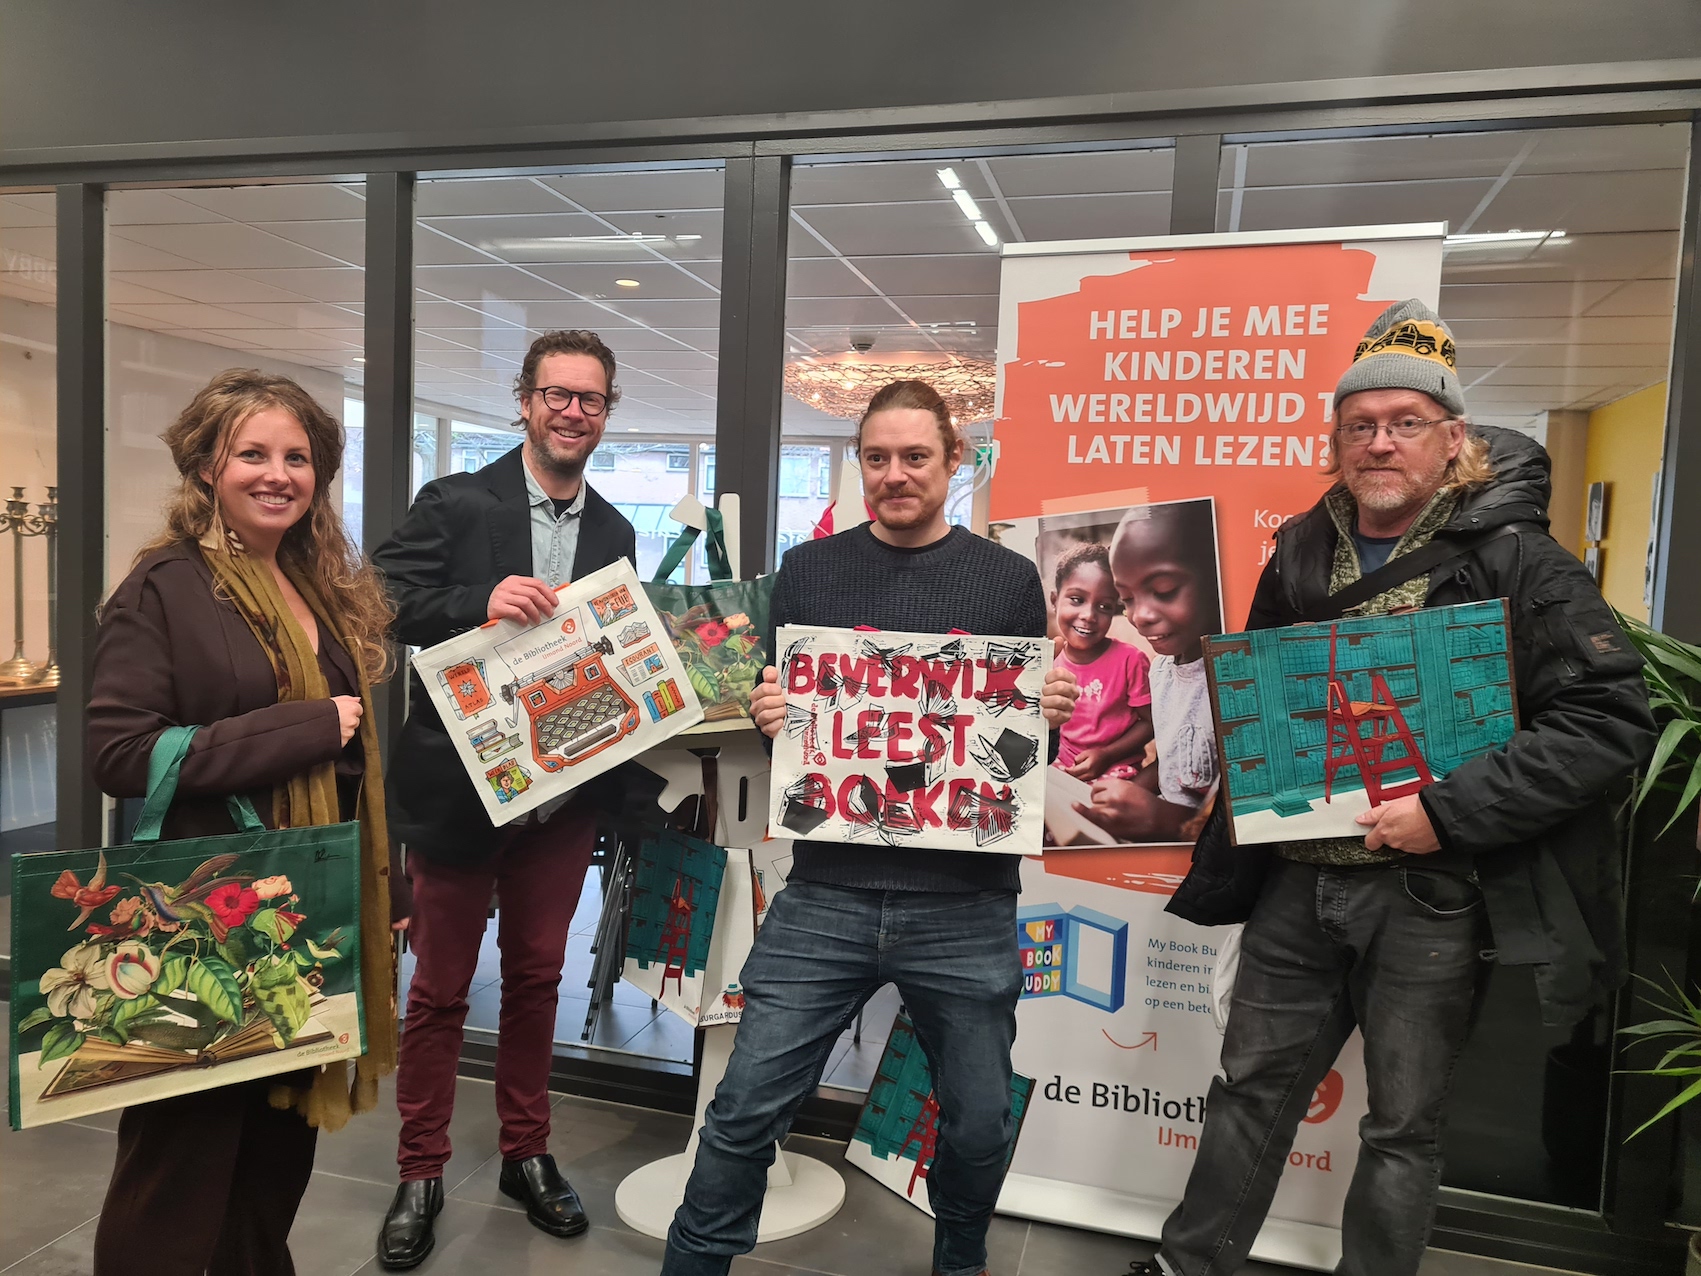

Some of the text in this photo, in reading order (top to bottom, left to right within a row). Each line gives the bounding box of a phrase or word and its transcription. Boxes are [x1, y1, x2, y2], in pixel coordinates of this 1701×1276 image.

[1089, 304, 1330, 340] HELP JE MEE
[1104, 349, 1307, 381] KINDEREN
[1049, 392, 1336, 424] WERELDWIJD T
[1067, 433, 1331, 467] LATEN LEZEN?
[1254, 509, 1294, 528] Ko
[512, 635, 567, 666] de Bibliotheek
[564, 637, 583, 650] Noord
[465, 697, 484, 709] ATLAS
[832, 710, 975, 767] LEEST
[1036, 924, 1054, 942] MY
[1148, 938, 1217, 956] My Book Bu
[1026, 947, 1061, 967] BOOK
[1147, 956, 1200, 973] kinderen
[1021, 974, 1061, 992] UDDY
[1146, 976, 1211, 994] lezen en bi
[1145, 997, 1160, 1009] op
[1163, 1000, 1184, 1010] een
[1044, 1075, 1206, 1124] de Biblioth
[1158, 1126, 1332, 1172] IJm ord
